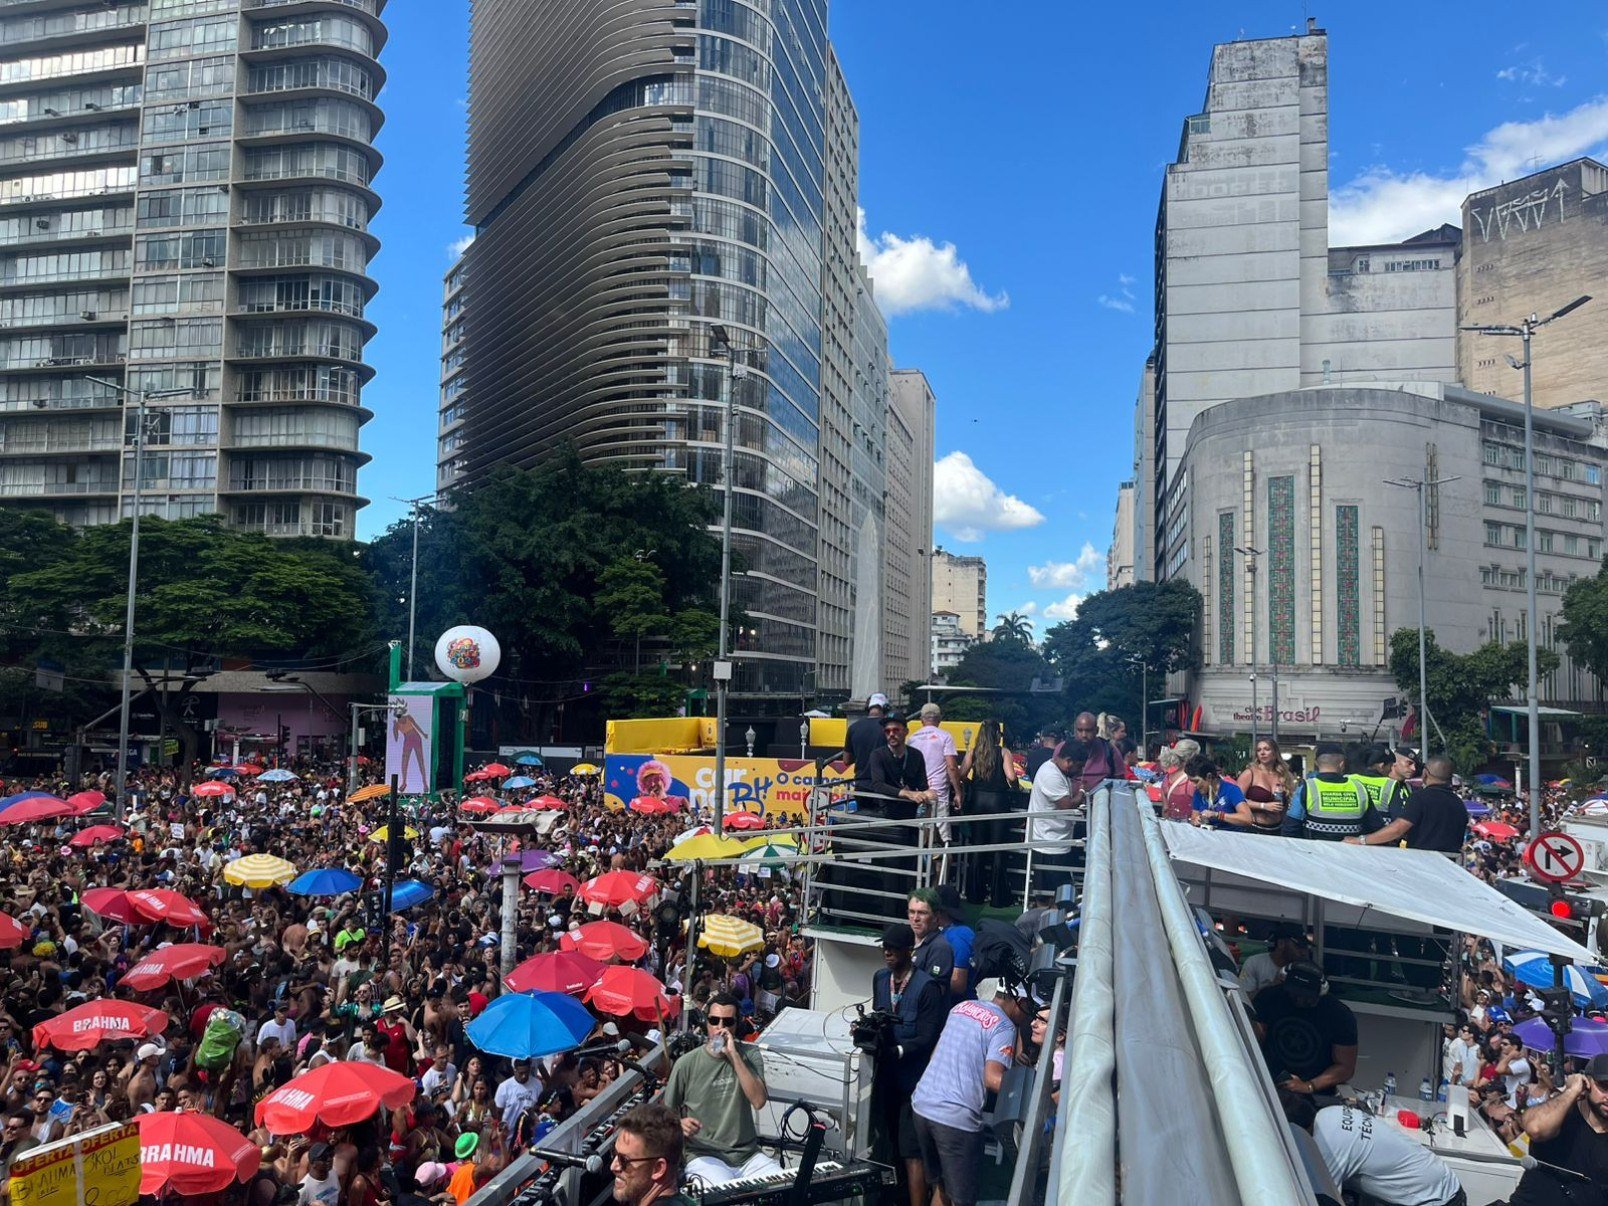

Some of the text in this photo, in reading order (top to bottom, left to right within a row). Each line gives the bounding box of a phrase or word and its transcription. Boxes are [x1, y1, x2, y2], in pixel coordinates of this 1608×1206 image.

[1264, 706, 1320, 722] Brasil
[777, 772, 789, 785] O
[73, 1016, 130, 1032] BRAHMA
[82, 1124, 137, 1151] OFERTA
[14, 1145, 75, 1173] OFERTA
